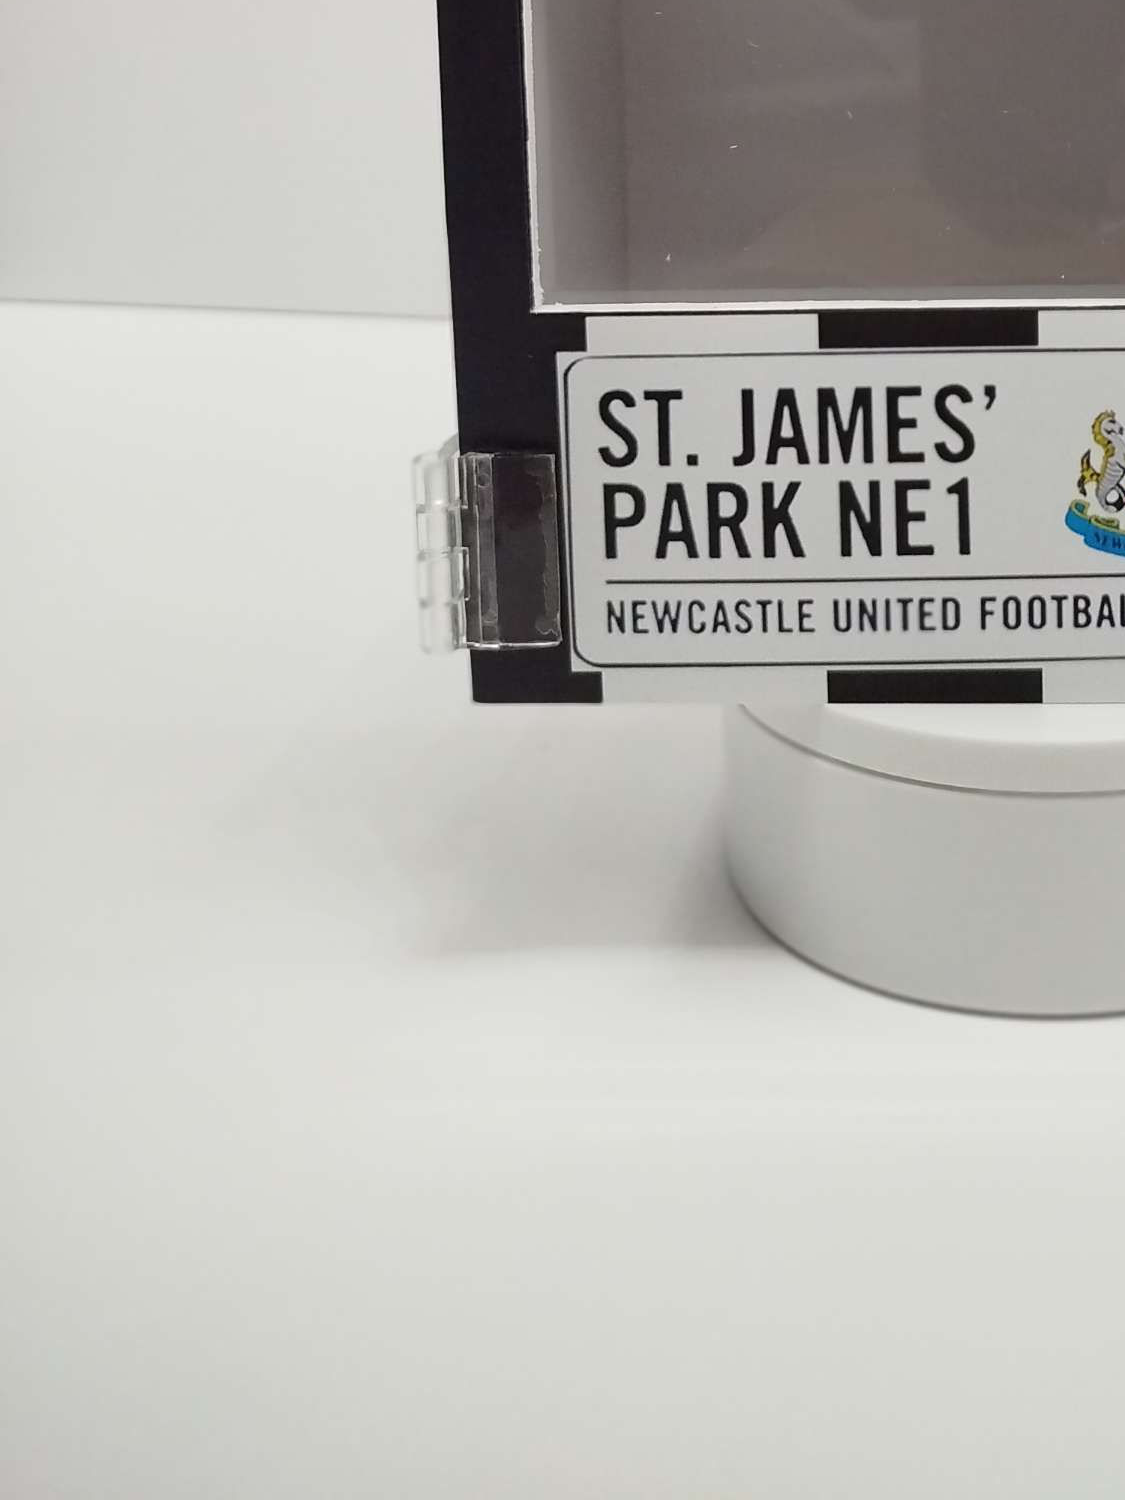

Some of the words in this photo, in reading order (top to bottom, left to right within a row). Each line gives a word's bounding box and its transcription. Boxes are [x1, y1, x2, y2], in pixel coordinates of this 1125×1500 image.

[597, 389, 699, 468] ST.
[732, 383, 997, 468] JAMES'
[604, 480, 807, 560] PARK
[838, 476, 972, 558] NE1
[605, 599, 816, 637] NEWCASTLE
[832, 595, 962, 633] UNITED
